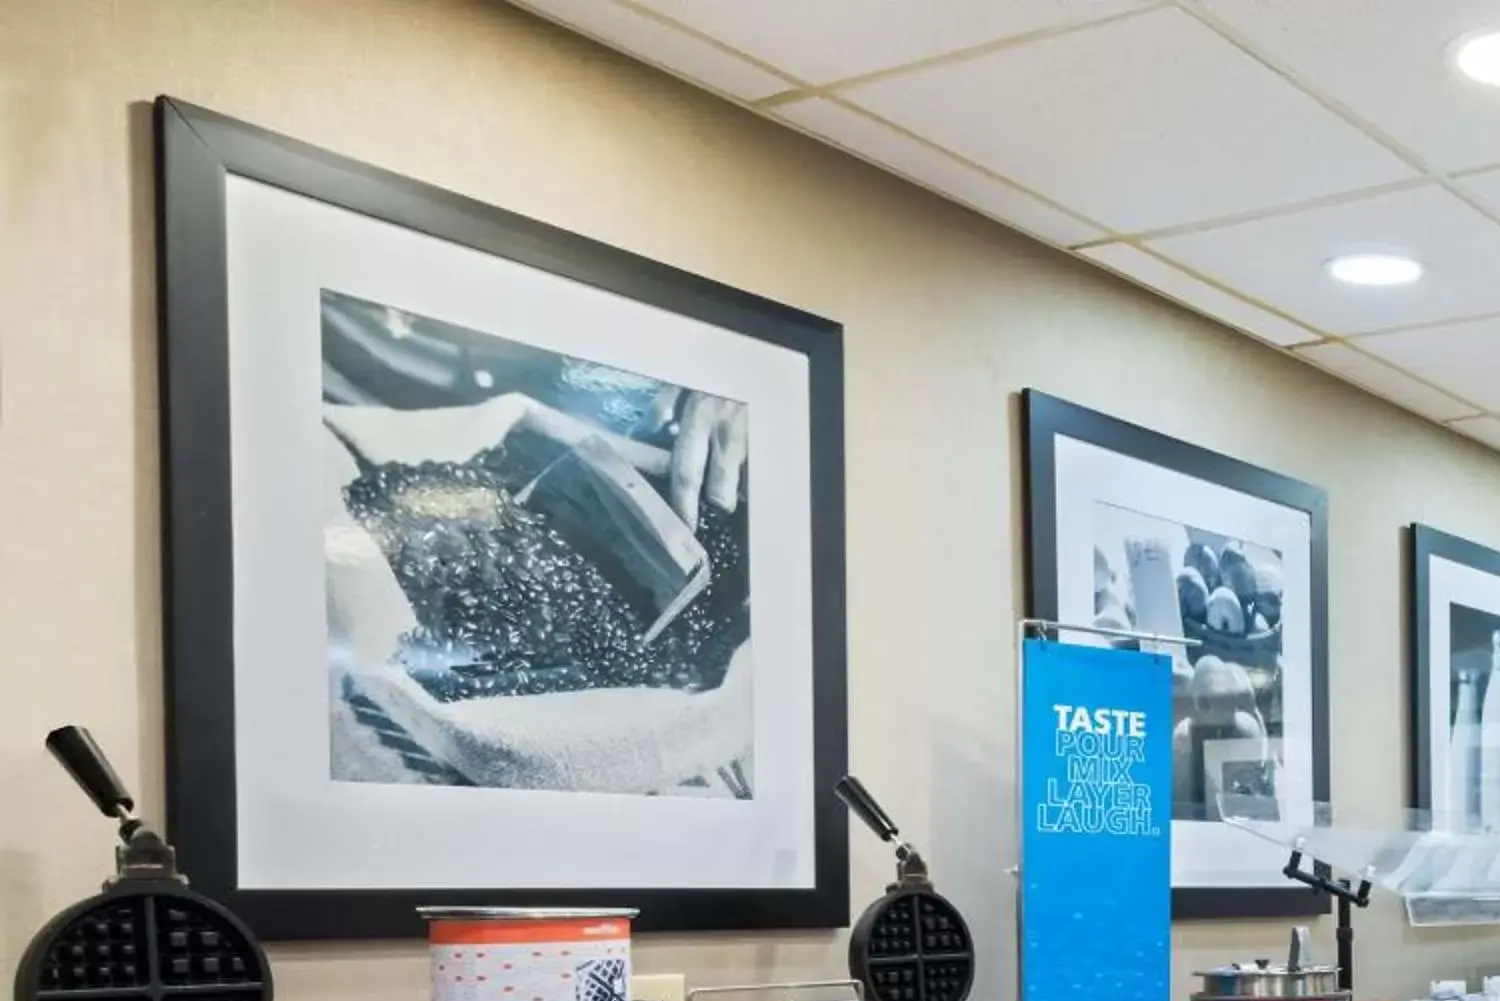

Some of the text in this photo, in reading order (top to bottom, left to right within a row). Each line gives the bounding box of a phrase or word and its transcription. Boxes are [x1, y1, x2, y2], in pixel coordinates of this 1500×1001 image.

[1053, 704, 1147, 737] TASTE
[1055, 728, 1145, 763] POUR
[1067, 754, 1133, 785] MIX
[1047, 777, 1152, 809] LAYER
[1037, 803, 1160, 836] LAUGH.
